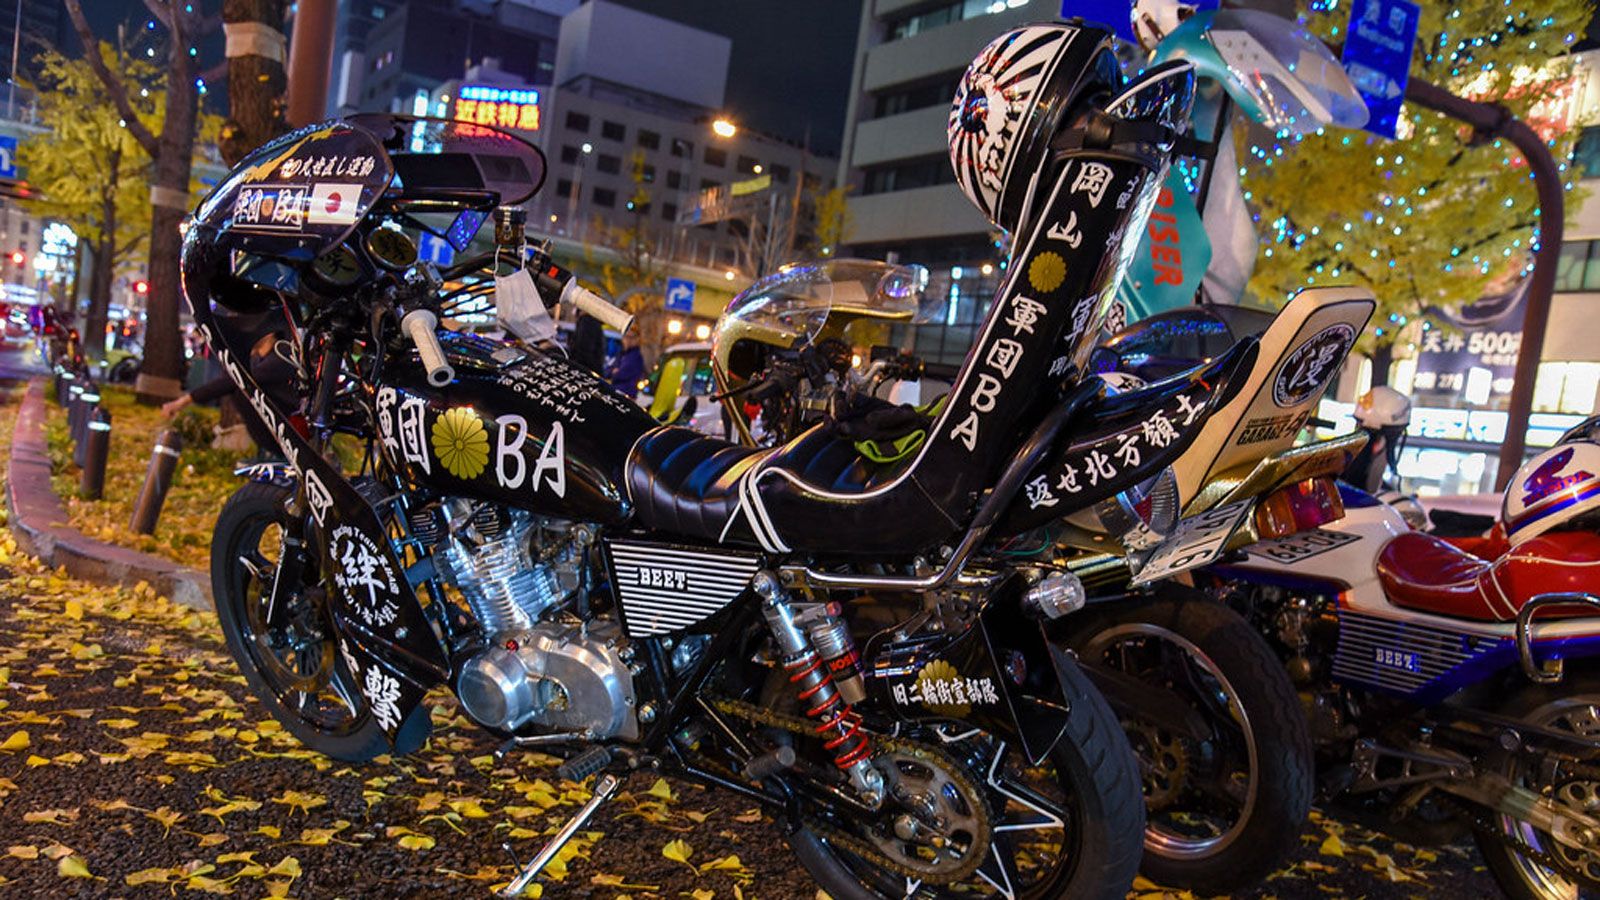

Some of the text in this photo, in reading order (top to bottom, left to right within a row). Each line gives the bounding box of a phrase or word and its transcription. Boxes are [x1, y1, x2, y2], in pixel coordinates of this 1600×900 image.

[454, 99, 540, 131] 近鉄特急
[233, 188, 304, 225] 軍団 BA
[1047, 161, 1115, 250] 岡山
[375, 385, 431, 476] 軍団
[494, 413, 566, 500] BA
[1025, 393, 1208, 511] 返せ北方領土
[640, 567, 686, 589] BEET
